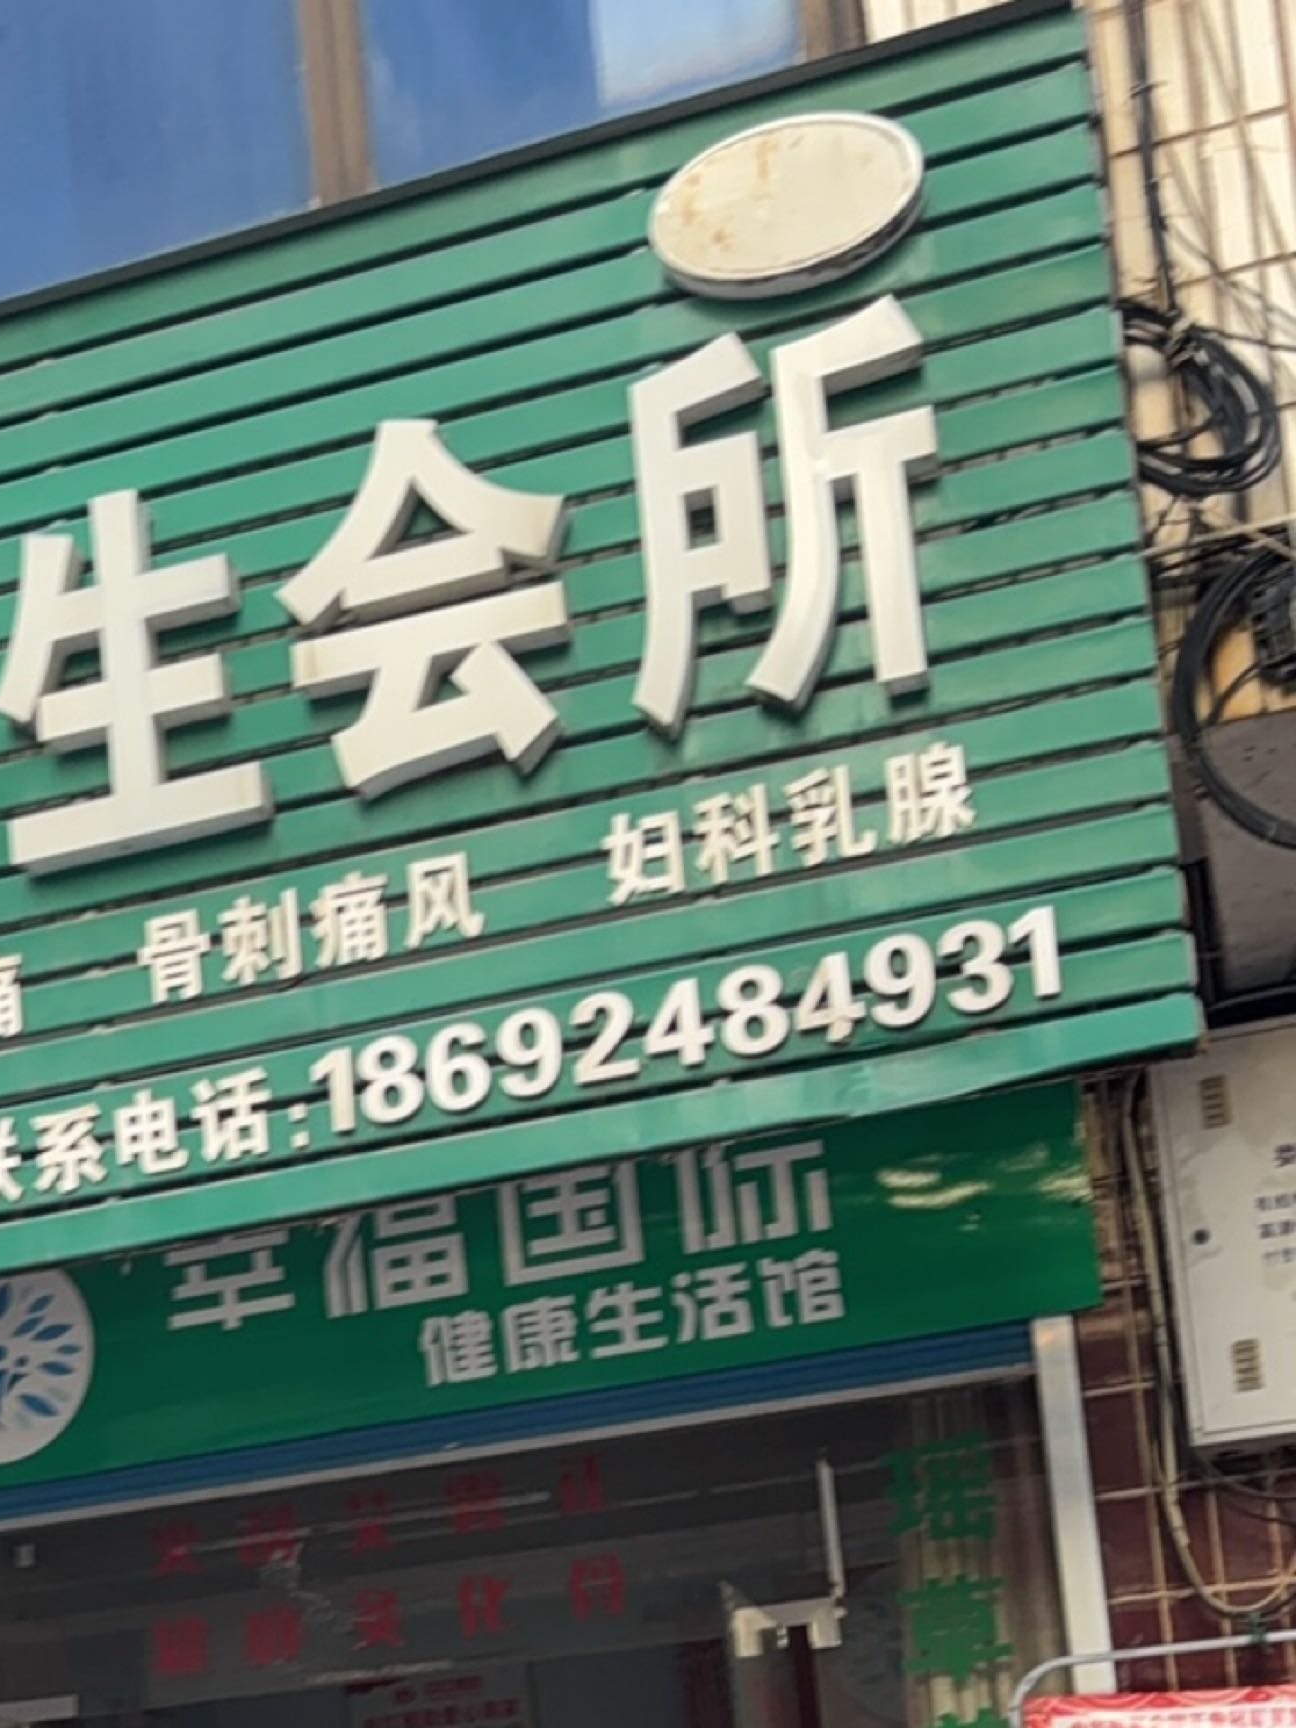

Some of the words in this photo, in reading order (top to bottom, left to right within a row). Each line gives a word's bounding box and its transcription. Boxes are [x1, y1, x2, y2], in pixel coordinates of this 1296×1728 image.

[137, 853, 484, 1003] 骨刺痛风
[602, 741, 974, 904] 妇科乳腺
[420, 1252, 844, 1386] 健康生活馆
